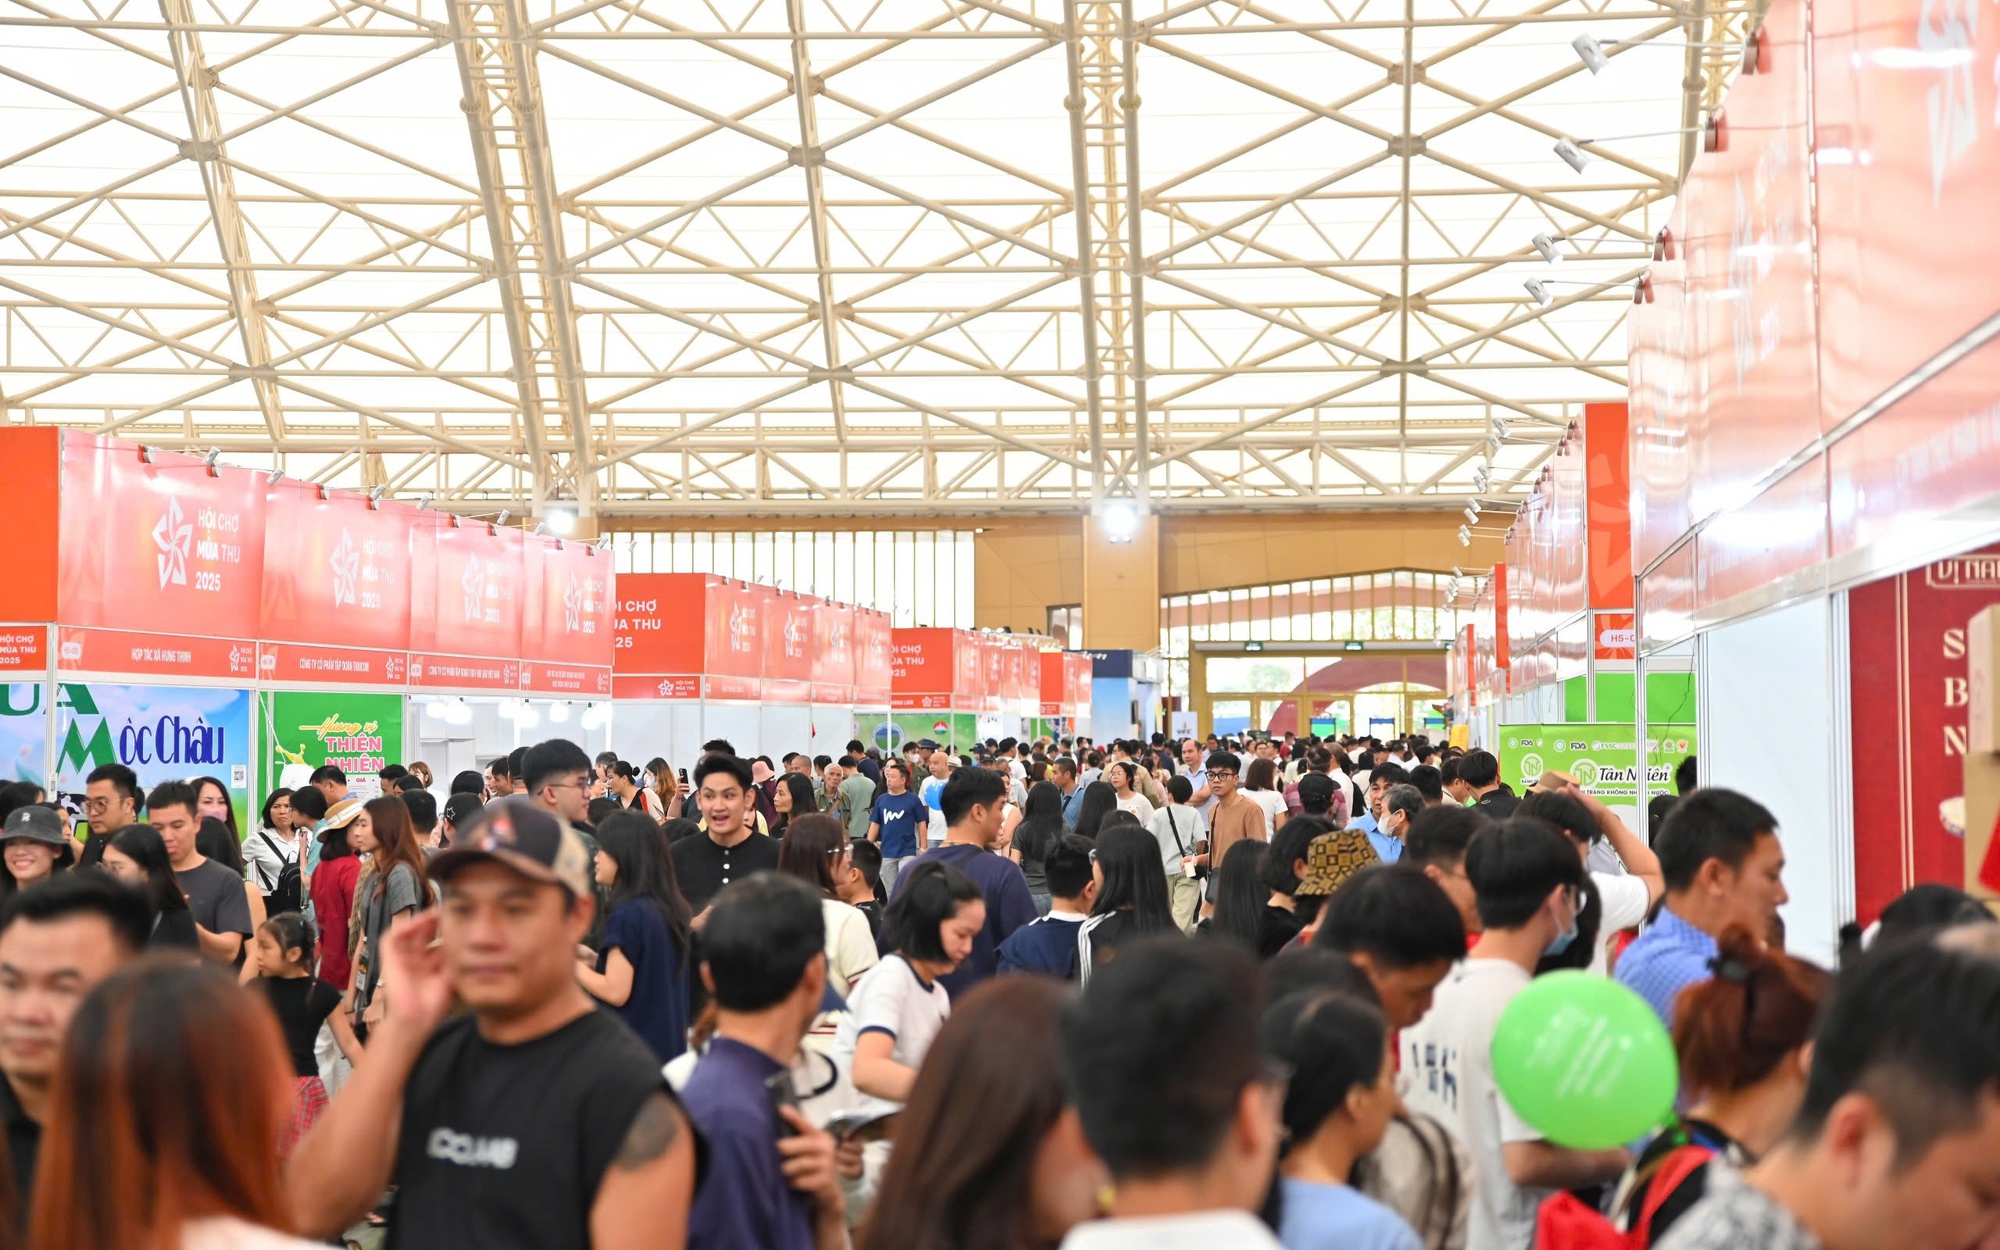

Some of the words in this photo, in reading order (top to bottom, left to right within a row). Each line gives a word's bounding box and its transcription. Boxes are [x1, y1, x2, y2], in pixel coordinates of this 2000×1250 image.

[198, 507, 216, 534] HỘI
[218, 513, 240, 537] CHỢ
[197, 537, 219, 560] MÙA
[221, 544, 241, 563] THU
[195, 571, 221, 591] 2025
[361, 592, 381, 609] 2025
[625, 599, 657, 615] CHỢ
[632, 619, 661, 630] THU
[16, 635, 34, 645] CHỢ
[615, 636, 633, 648] 25
[900, 644, 922, 656] CHỢ
[905, 657, 925, 665] THU
[155, 715, 225, 764] Châu
[325, 733, 382, 751] THIÊN
[1570, 742, 1587, 750] FDA
[325, 754, 385, 772] NHIÊN
[1600, 767, 1623, 781] Tân
[1626, 768, 1668, 781] Niên
